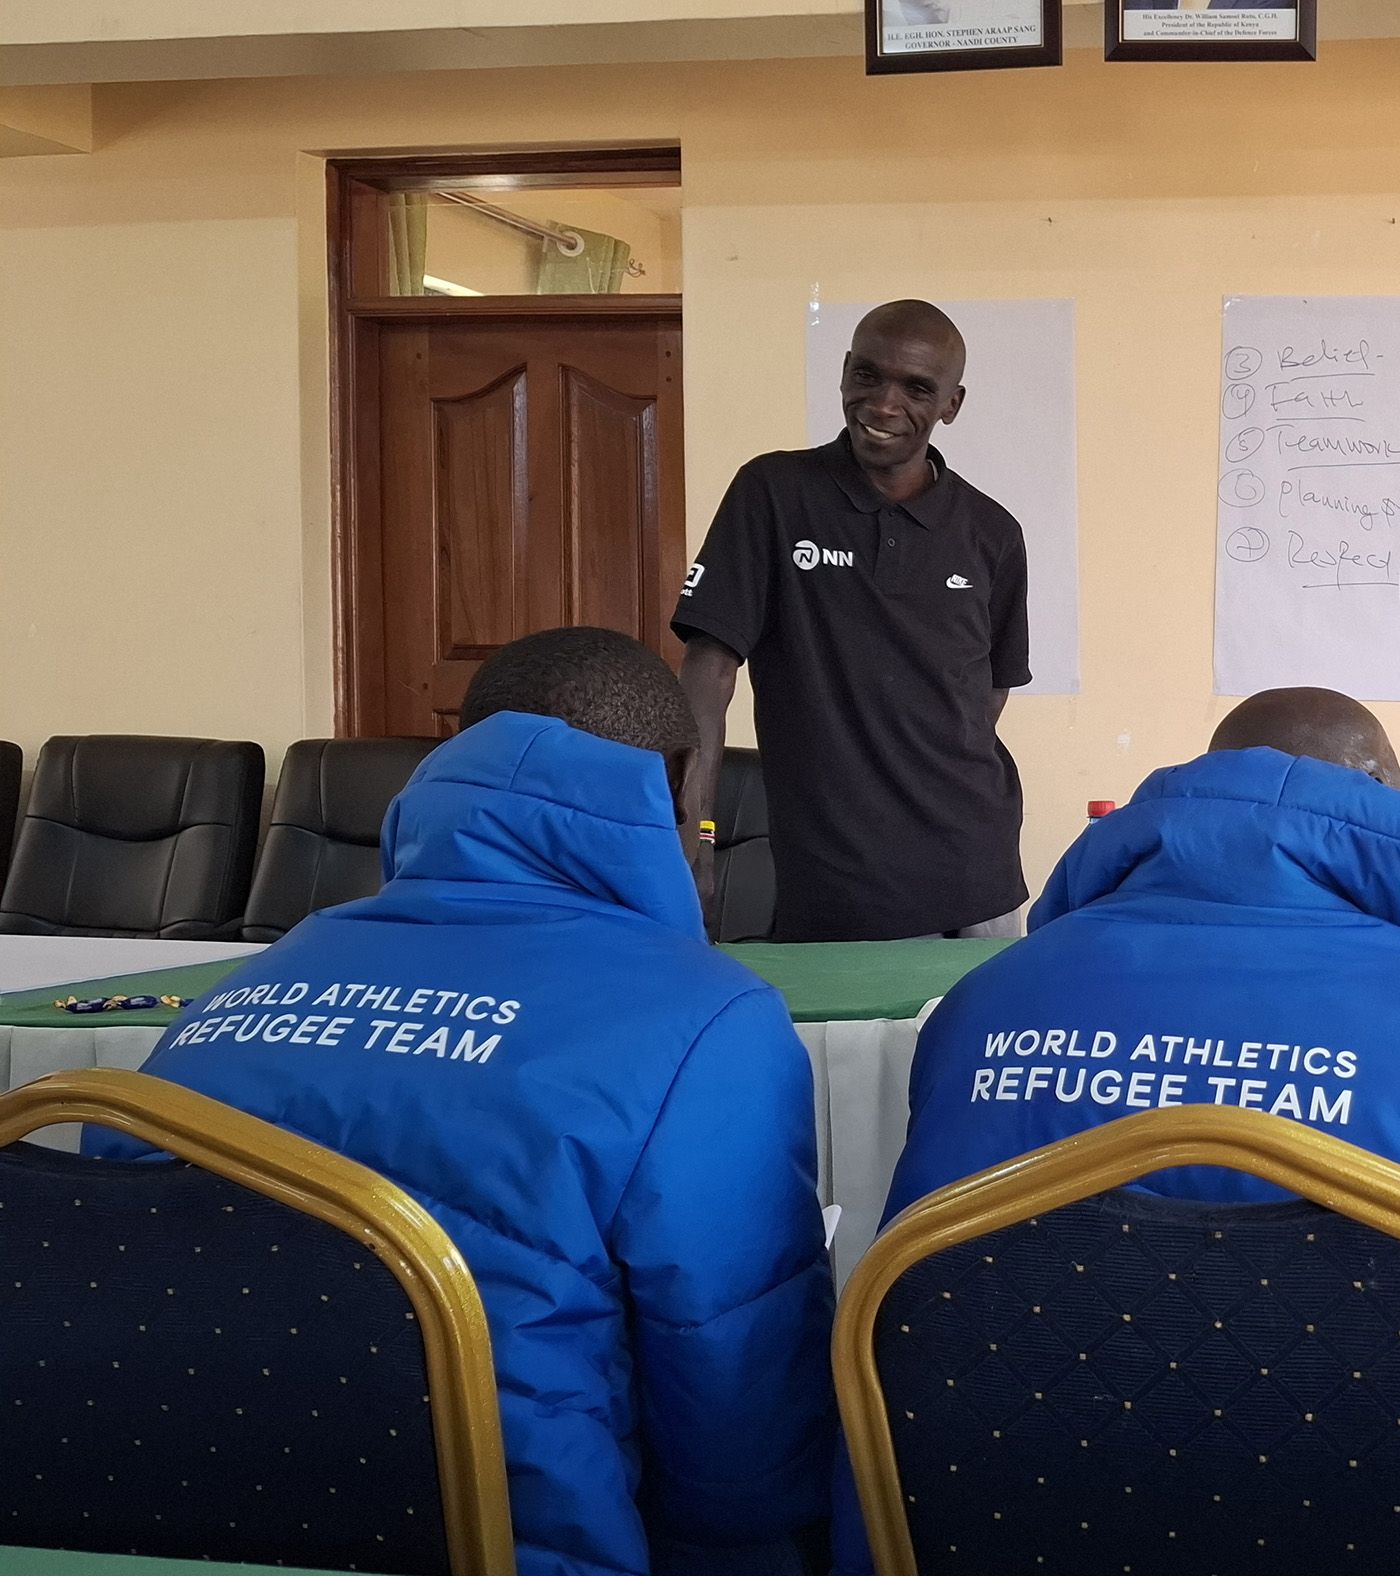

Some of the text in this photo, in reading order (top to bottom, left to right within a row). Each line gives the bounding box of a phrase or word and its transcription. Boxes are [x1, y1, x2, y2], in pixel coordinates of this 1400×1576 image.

[905, 40, 950, 48] GOVERNOR
[984, 36, 1018, 45] COUNTY
[946, 28, 983, 38] STEPHEN
[1014, 25, 1036, 33] SANG
[822, 548, 853, 567] NN
[202, 982, 521, 1025] WORLD ATHLETICS
[169, 1013, 502, 1064] REFUGEE TEAM
[984, 1029, 1359, 1079] WORLD ATHLETICS
[970, 1067, 1353, 1125] REFUGEE TEAM
